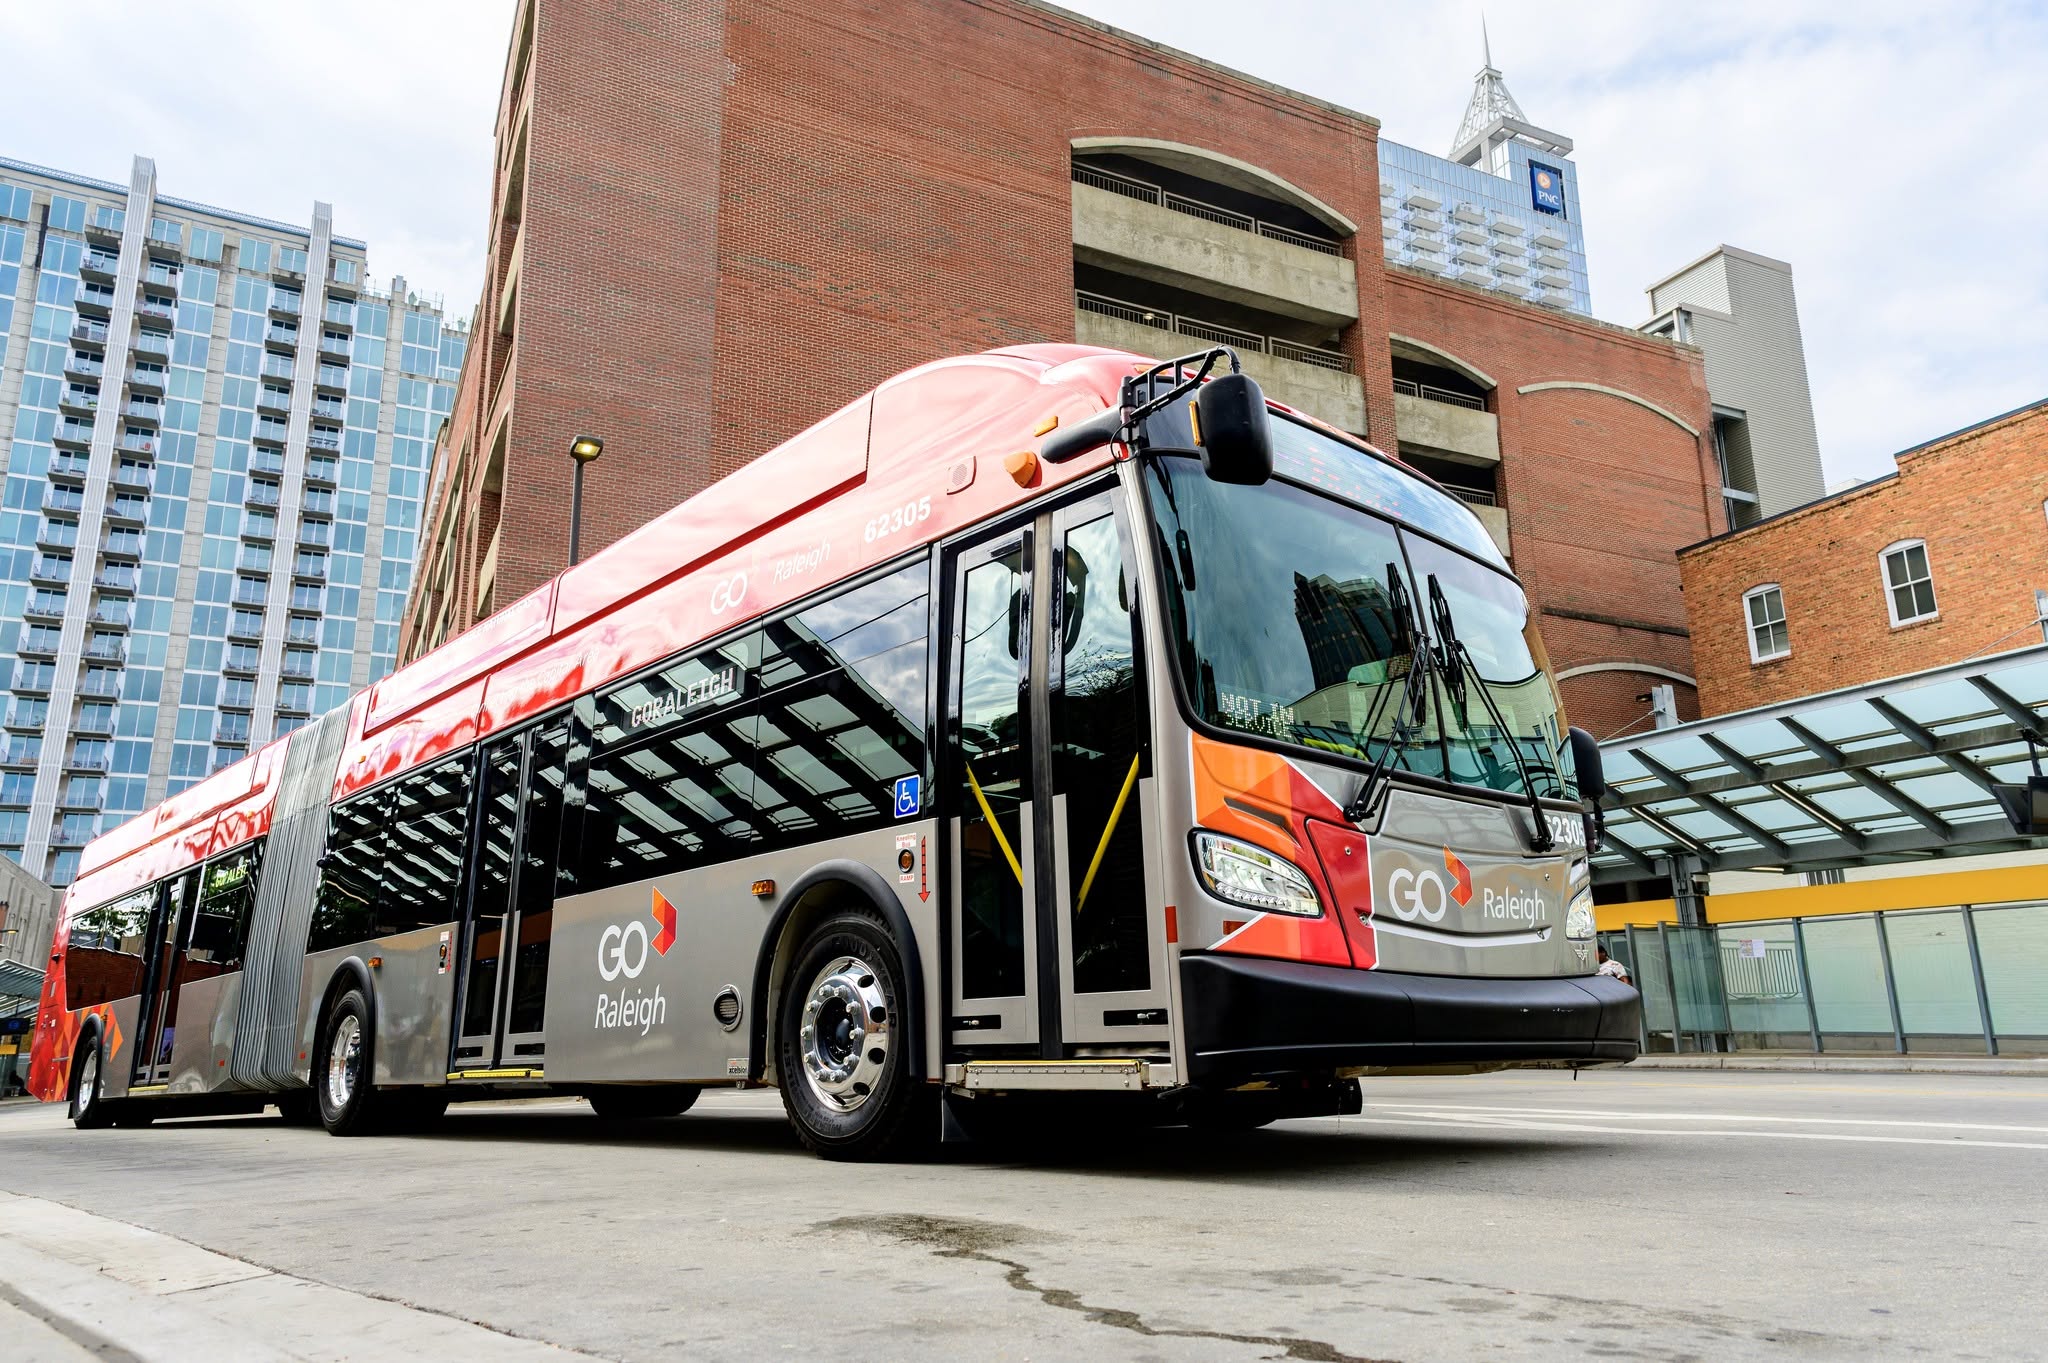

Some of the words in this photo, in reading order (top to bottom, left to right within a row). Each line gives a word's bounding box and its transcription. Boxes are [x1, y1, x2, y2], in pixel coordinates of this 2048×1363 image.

[1538, 190, 1560, 205] PNC
[864, 495, 931, 543] 62305
[710, 571, 748, 615] GO
[773, 537, 831, 584] Raleigh
[631, 667, 734, 728] GORALEIGH
[1221, 692, 1261, 724] NOT
[1388, 868, 1447, 923] GO
[1483, 886, 1545, 929] Raleigh
[598, 920, 648, 982] GO
[594, 983, 666, 1037] Raleigh
